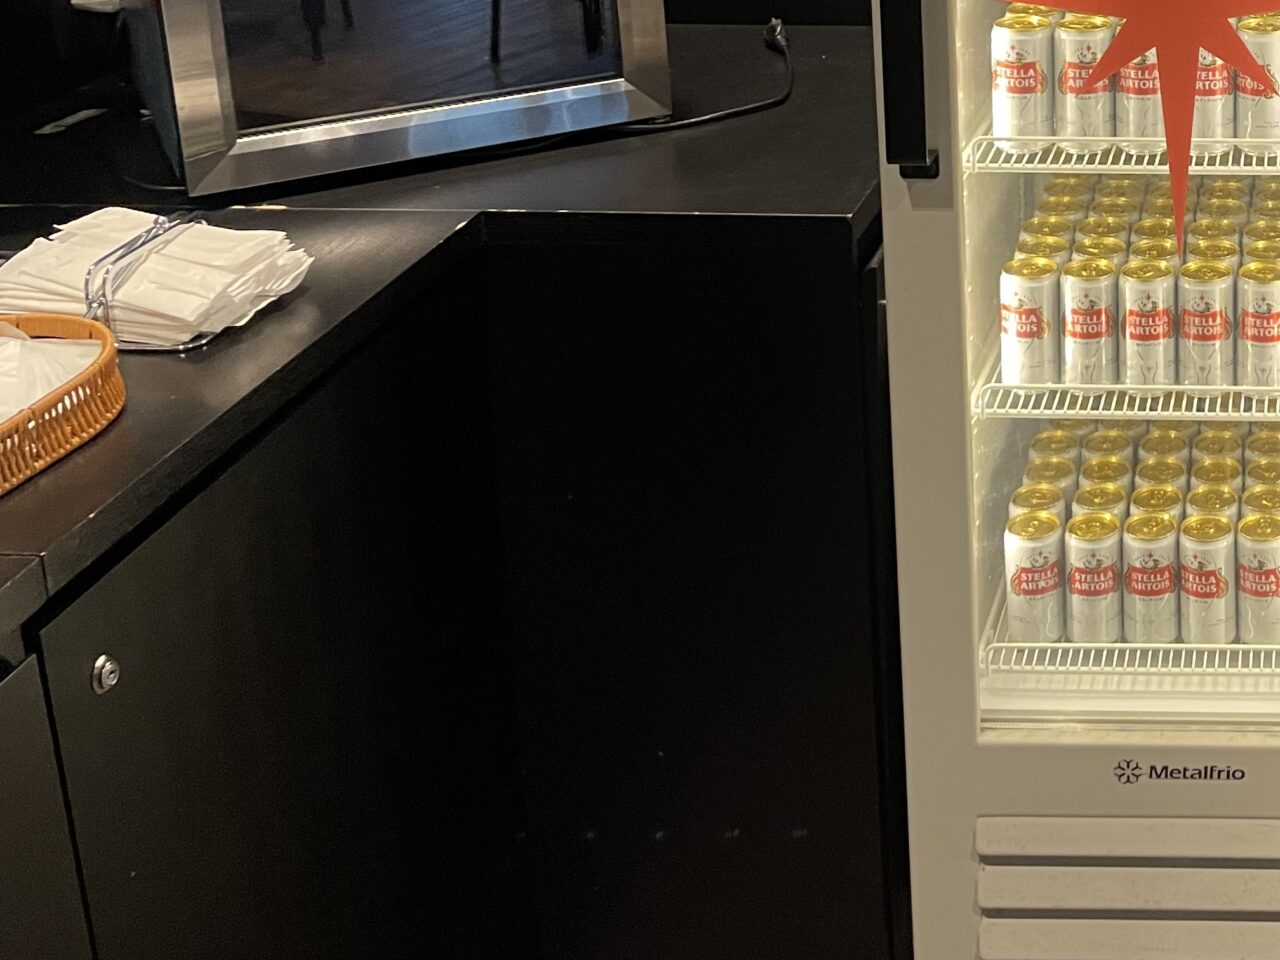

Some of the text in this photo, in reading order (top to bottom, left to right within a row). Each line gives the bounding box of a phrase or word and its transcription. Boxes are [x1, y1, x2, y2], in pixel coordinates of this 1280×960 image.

[1120, 68, 1158, 78] STELLA
[1197, 71, 1228, 80] TELLA
[1119, 78, 1159, 89] ARTOIS
[1196, 80, 1229, 89] RTOIS
[1129, 316, 1168, 326] STELLA
[1184, 316, 1222, 326] STELLA
[1129, 325, 1169, 335] ARTOIS
[1184, 325, 1223, 335] ARTOIS
[1020, 567, 1059, 582] STELLA
[1074, 571, 1113, 582] STELLA
[1132, 572, 1170, 582] STELLA
[1181, 571, 1215, 584] STELLA
[1240, 570, 1276, 583] STELLA
[1020, 576, 1060, 590] ARTOIS
[1074, 581, 1114, 591] ARTOIS
[1131, 581, 1170, 591] ARTOIS
[1181, 580, 1217, 593] ARTOIS
[1239, 580, 1277, 592] ARTOIS
[1149, 765, 1246, 780] Metalfrio
